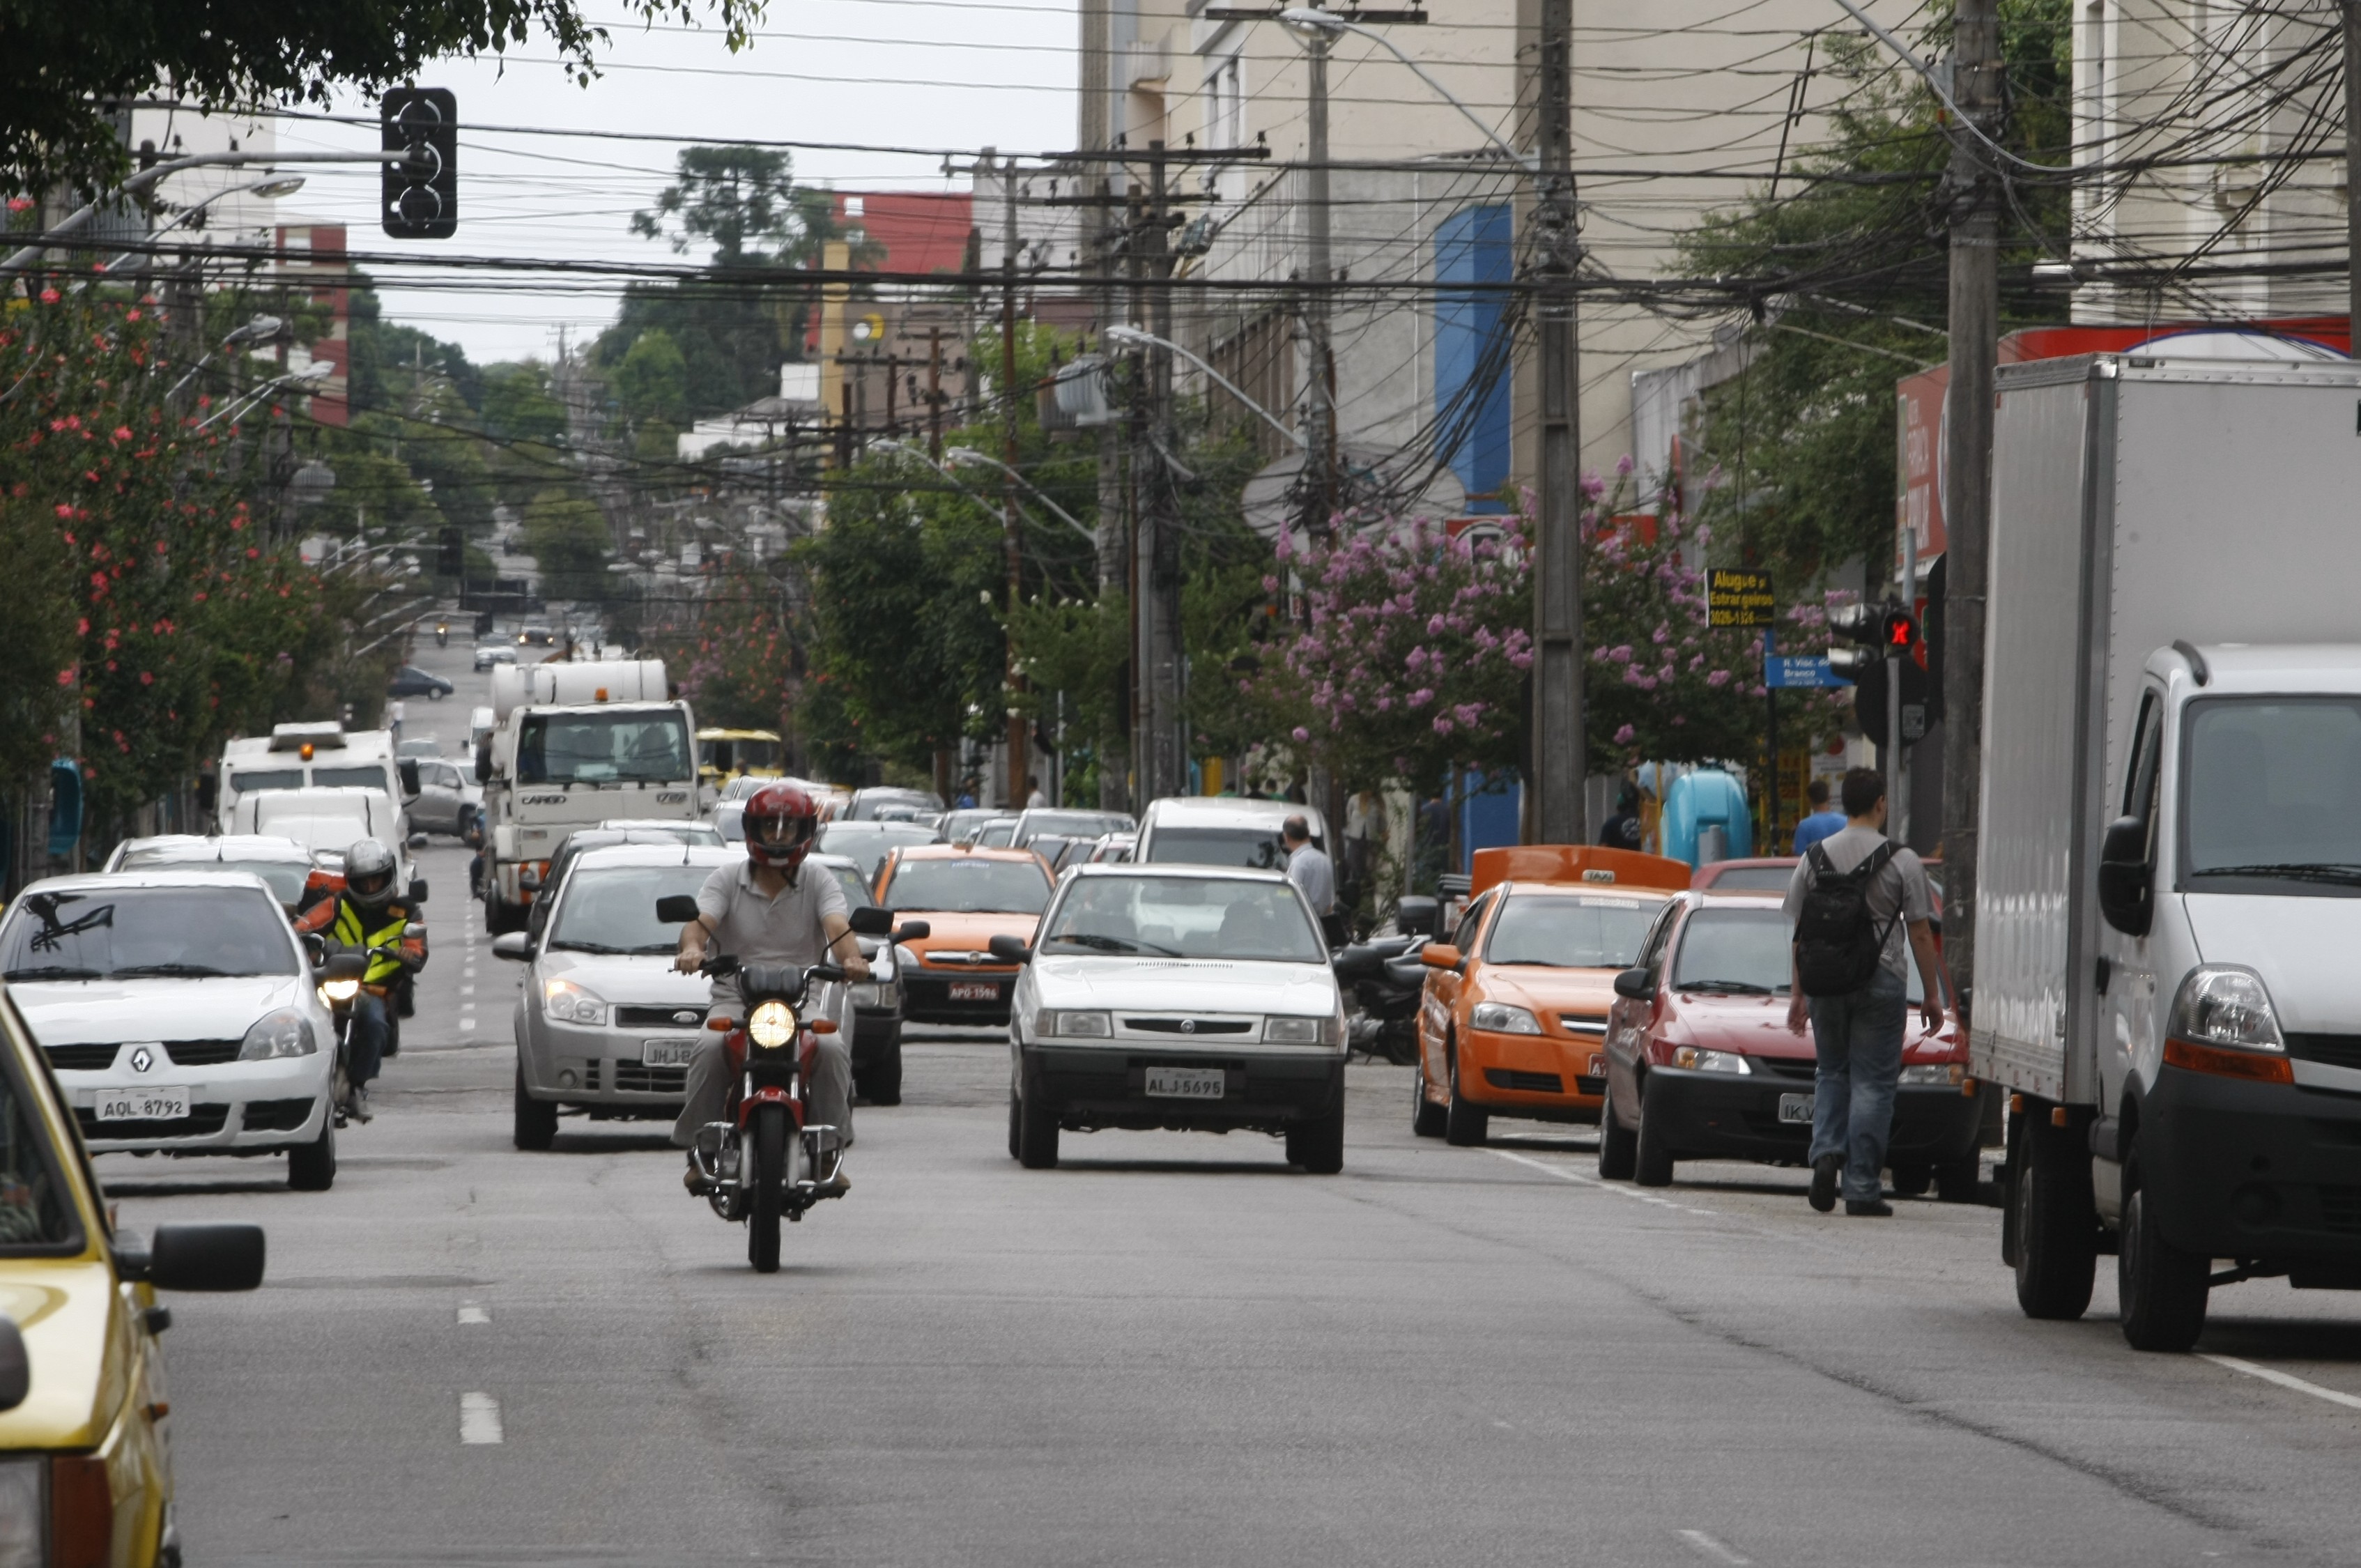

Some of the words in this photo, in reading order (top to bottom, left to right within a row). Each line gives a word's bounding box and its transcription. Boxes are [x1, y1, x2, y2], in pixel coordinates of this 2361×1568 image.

[1714, 570, 1756, 592] Alugue
[1709, 591, 1774, 610] Estrangeiros
[1783, 668, 1816, 679] Branco
[522, 794, 567, 804] CARGO
[1587, 871, 1613, 881] TAXI
